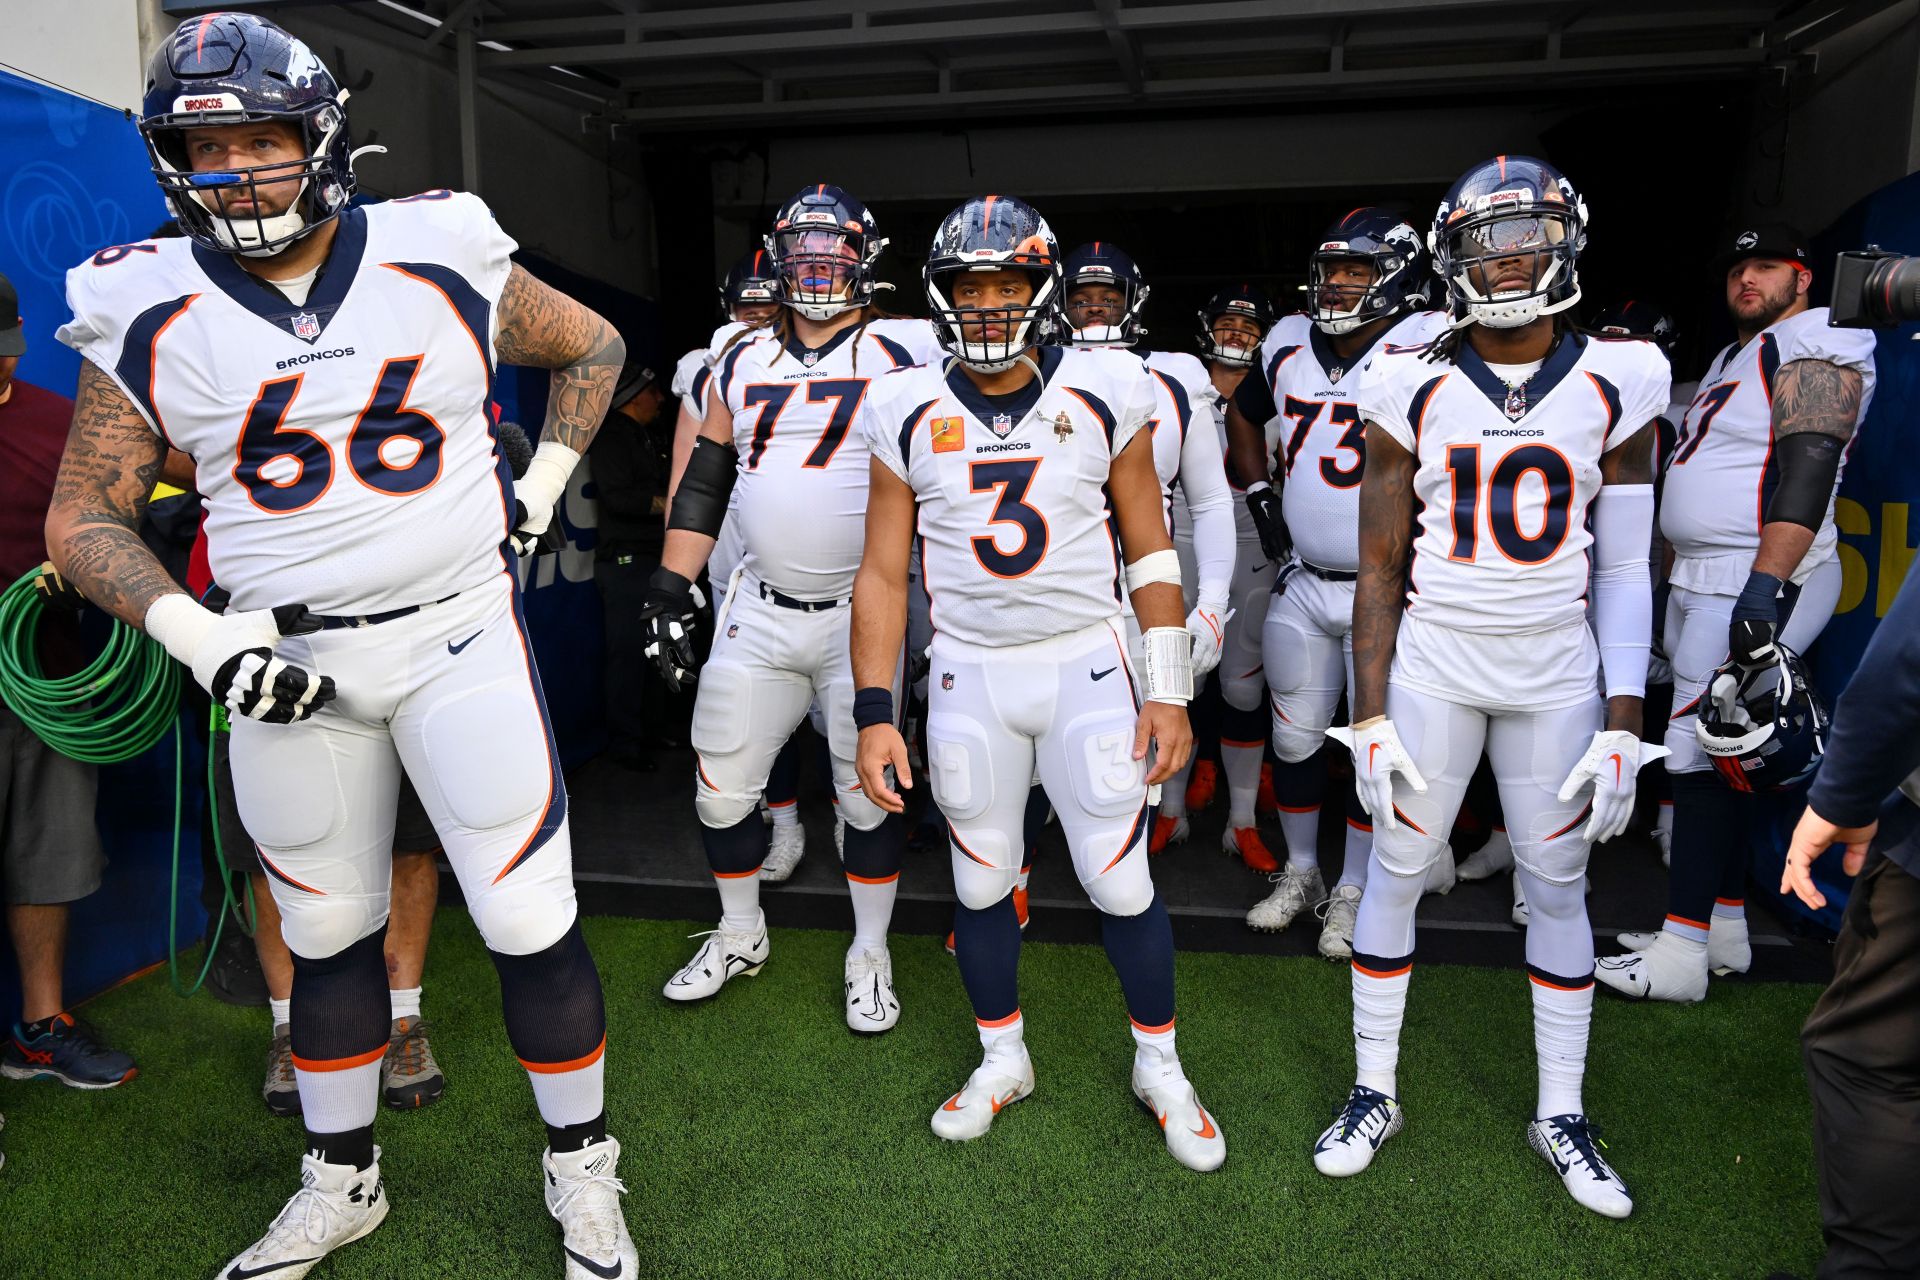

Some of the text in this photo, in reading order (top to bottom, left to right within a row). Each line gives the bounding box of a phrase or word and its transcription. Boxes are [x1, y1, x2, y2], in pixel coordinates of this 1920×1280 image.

[184, 98, 223, 111] BRONCOS
[1490, 193, 1520, 203] BRONCOS
[297, 324, 317, 336] NFL
[276, 347, 355, 370] BRONCOS
[783, 371, 828, 380] BRONCOS
[743, 378, 872, 470] 77
[1482, 429, 1545, 437] BRONCOS
[232, 353, 447, 514] 66
[1283, 393, 1366, 490] 73
[976, 442, 1031, 454] BRONCOS
[1445, 442, 1575, 566] 10
[968, 456, 1050, 580] 3
[1703, 743, 1743, 753] BRONCOS
[1097, 728, 1138, 792] 3
